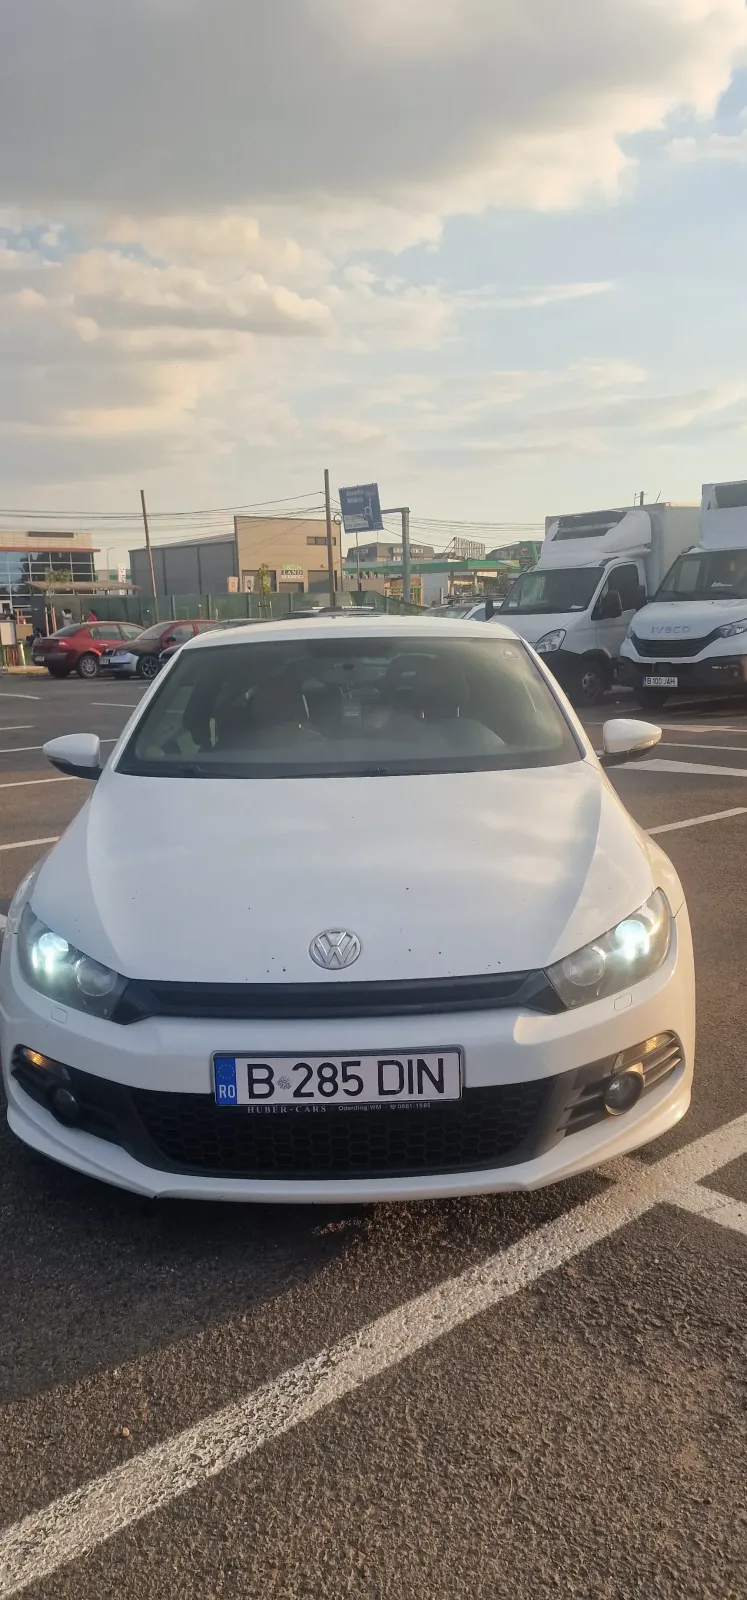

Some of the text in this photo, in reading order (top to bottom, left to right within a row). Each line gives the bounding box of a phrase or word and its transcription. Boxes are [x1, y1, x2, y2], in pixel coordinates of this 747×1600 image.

[219, 1084, 235, 1099] RO
[247, 1057, 444, 1099] B 285 DIN
